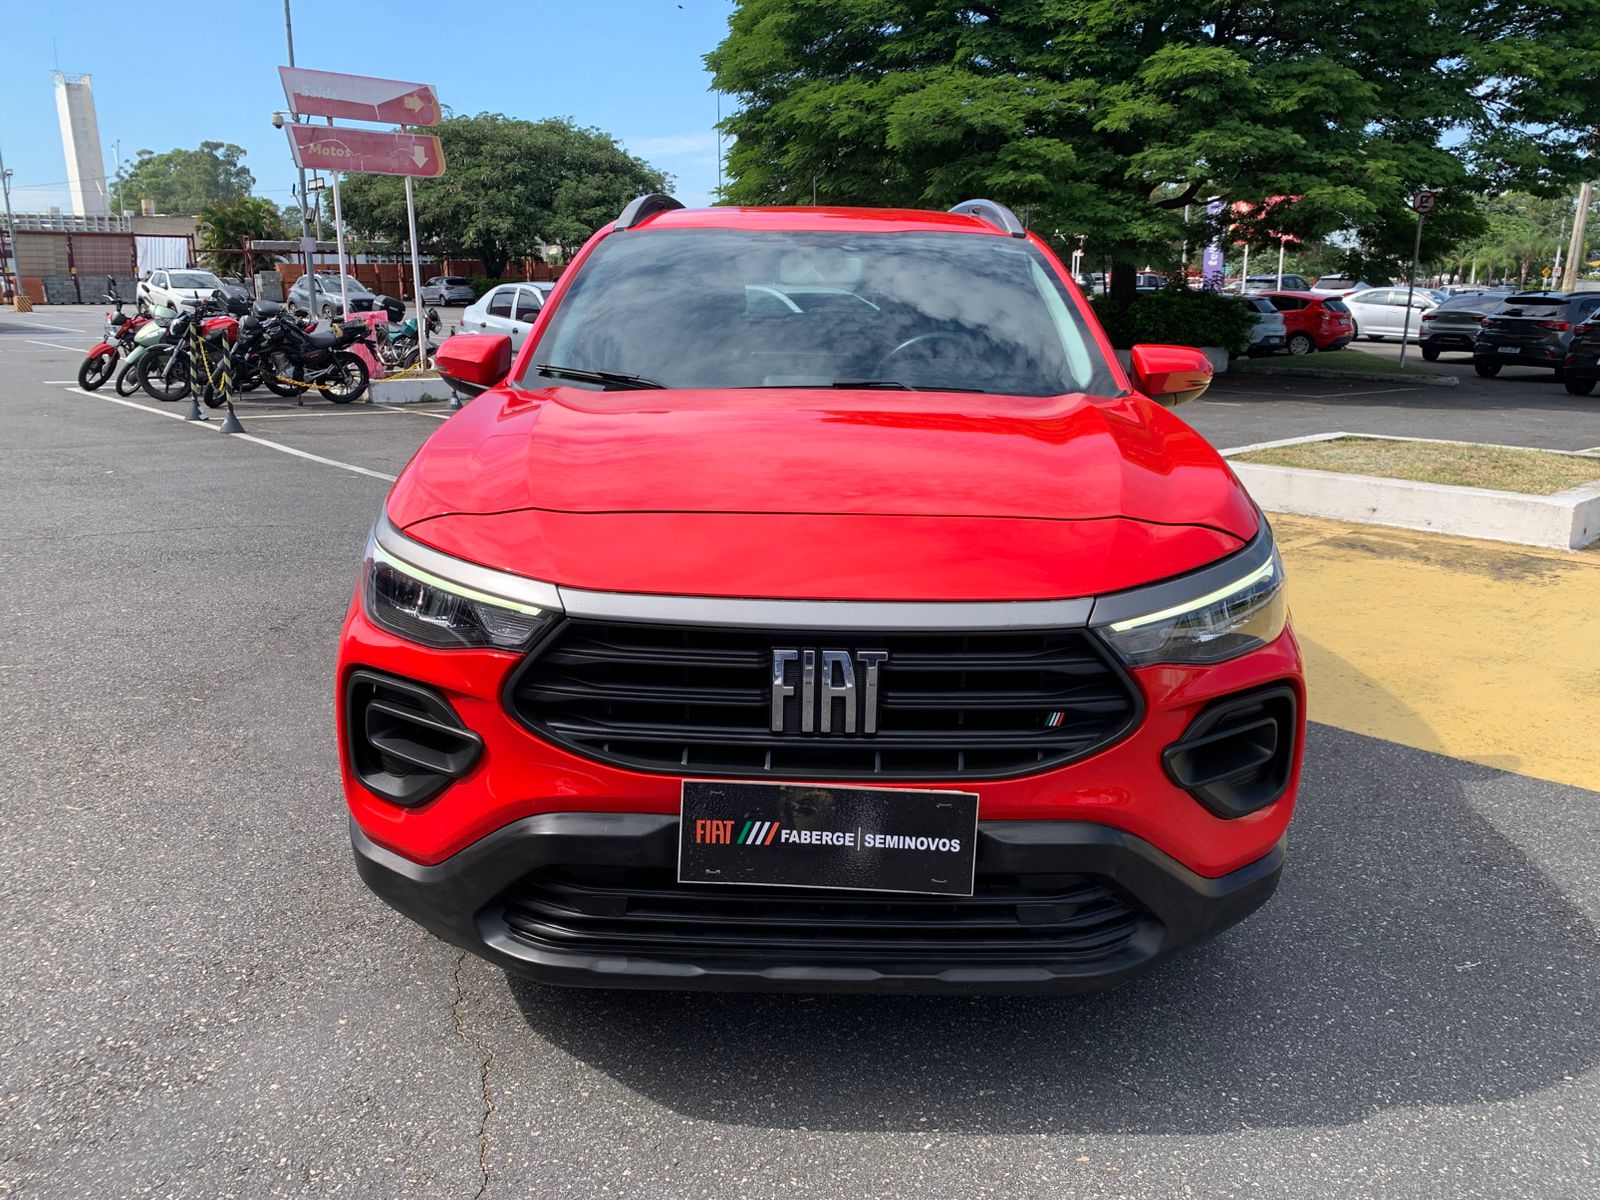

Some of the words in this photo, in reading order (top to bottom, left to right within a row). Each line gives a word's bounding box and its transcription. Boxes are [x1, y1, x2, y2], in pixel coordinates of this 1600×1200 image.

[308, 143, 351, 158] Motos
[771, 649, 889, 734] FIAT
[695, 819, 735, 845] FIAT
[780, 828, 855, 846] FABERGE
[864, 833, 961, 853] SEMINOVOS
